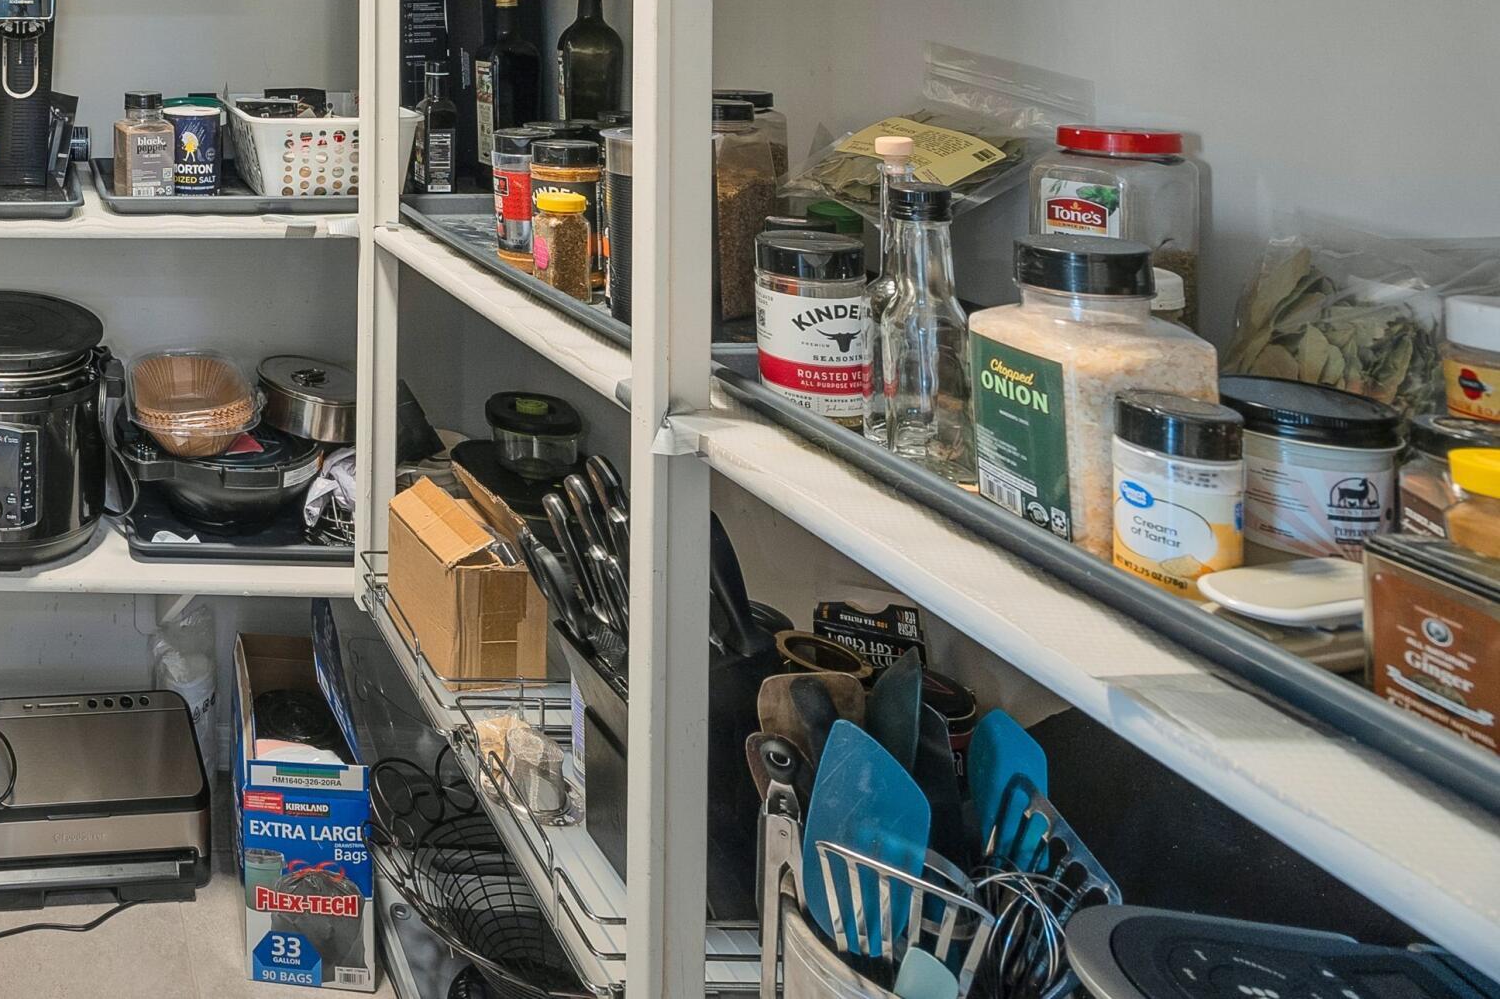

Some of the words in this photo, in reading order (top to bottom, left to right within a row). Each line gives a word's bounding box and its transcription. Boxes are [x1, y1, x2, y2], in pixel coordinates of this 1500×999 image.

[136, 143, 167, 154] pepper
[198, 175, 216, 184] SALT
[1051, 204, 1102, 225] Tone's
[791, 304, 862, 332] KINDE
[812, 354, 863, 362] SEASONIN
[797, 368, 849, 381] ROASTED
[990, 358, 1035, 385] Chopped
[981, 370, 1049, 414] ONION
[1133, 515, 1178, 536] Cream
[1131, 526, 1141, 536] of
[1144, 528, 1182, 548] Tartar
[1151, 571, 1163, 581] OZ
[839, 613, 863, 625] FILTERS
[864, 618, 876, 627] TEA
[1404, 650, 1475, 693] Ginger
[272, 776, 342, 787] RM1640-326-20RA
[285, 803, 329, 812] KIRKLAND
[249, 819, 306, 841] EXTRA
[334, 848, 368, 864] Bags
[256, 886, 359, 917] FLEX-TECH
[271, 935, 301, 958] 33
[272, 956, 301, 965] GALLON
[262, 969, 276, 980] 90
[280, 971, 313, 984] BAGS
